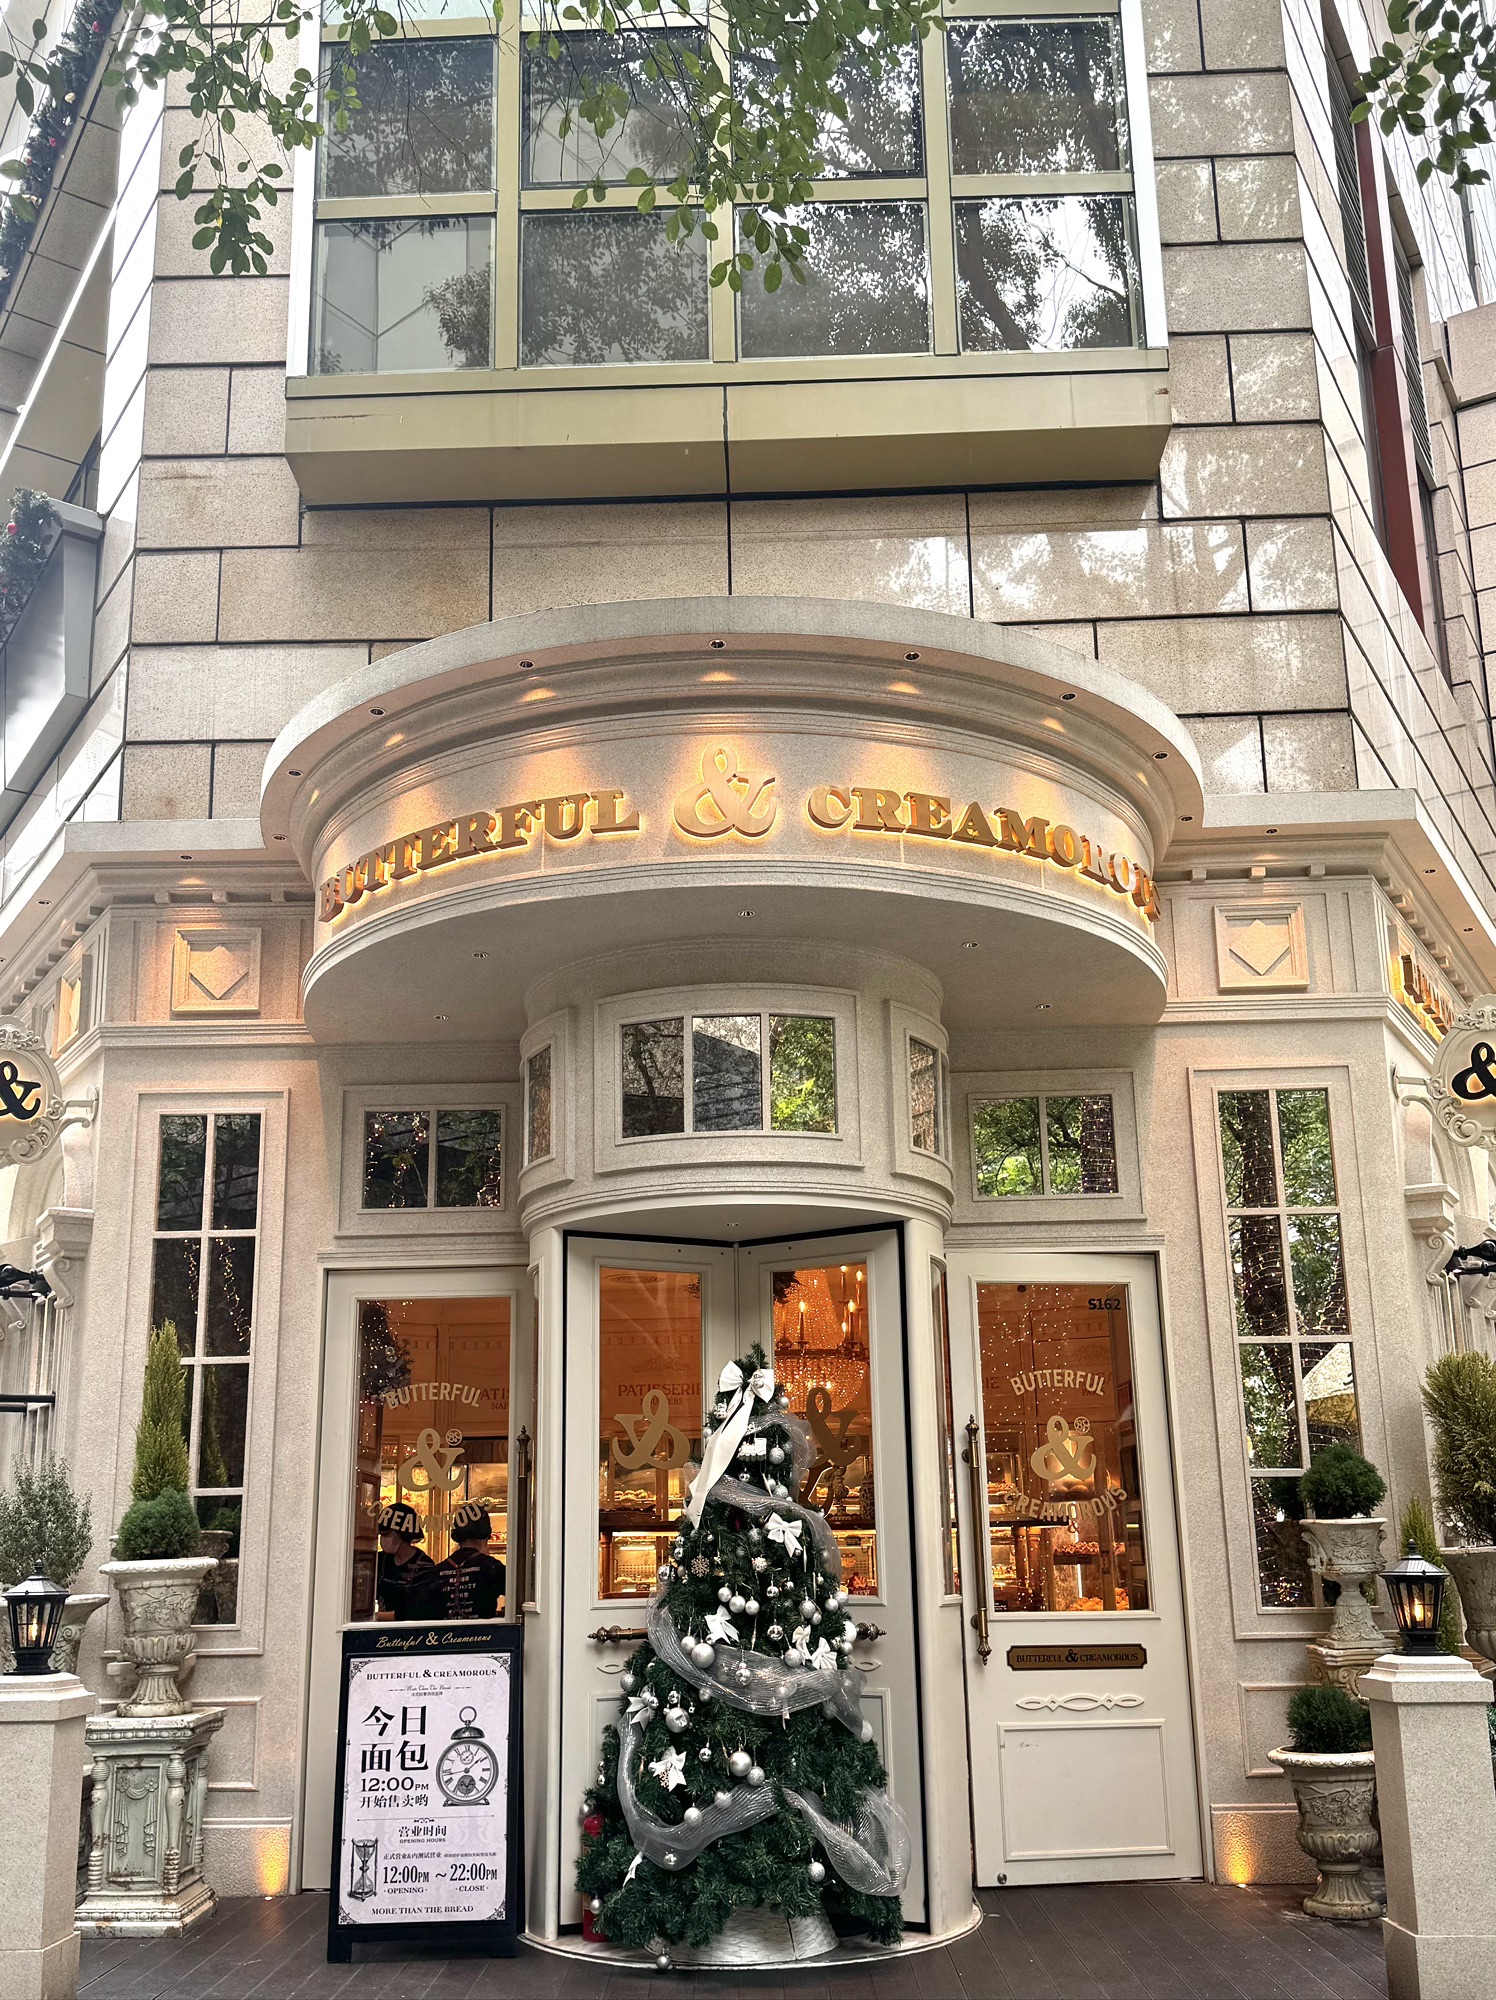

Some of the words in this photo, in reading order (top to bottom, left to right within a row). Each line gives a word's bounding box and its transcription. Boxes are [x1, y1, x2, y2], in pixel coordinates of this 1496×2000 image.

[318, 789, 640, 923] BUTTERFUL
[673, 742, 777, 839] &
[1087, 1297, 1121, 1310] S162
[384, 1382, 481, 1410] BUTTERFUL
[1010, 1369, 1105, 1396] BUTTERFUL
[398, 1428, 466, 1492] &
[1031, 1415, 1097, 1481] &
[1003, 1486, 1128, 1522] CREAMOROUS
[376, 1636, 423, 1650] Butterful
[425, 1631, 439, 1646] &
[441, 1632, 491, 1644] Creamorous
[1065, 1649, 1079, 1663] &
[1080, 1653, 1138, 1663] CREAMOROUS
[366, 1671, 421, 1680] BUTTERFUL
[422, 1669, 432, 1678] &
[433, 1669, 498, 1678] CREAMOROUS
[361, 1705, 427, 1736] 今日
[360, 1740, 429, 1773] 面包
[360, 1794, 428, 1808] 开始售卖哟
[398, 1825, 447, 1837] 营业时间
[371, 1907, 399, 1915] MORE
[444, 1905, 474, 1913] BREAD
